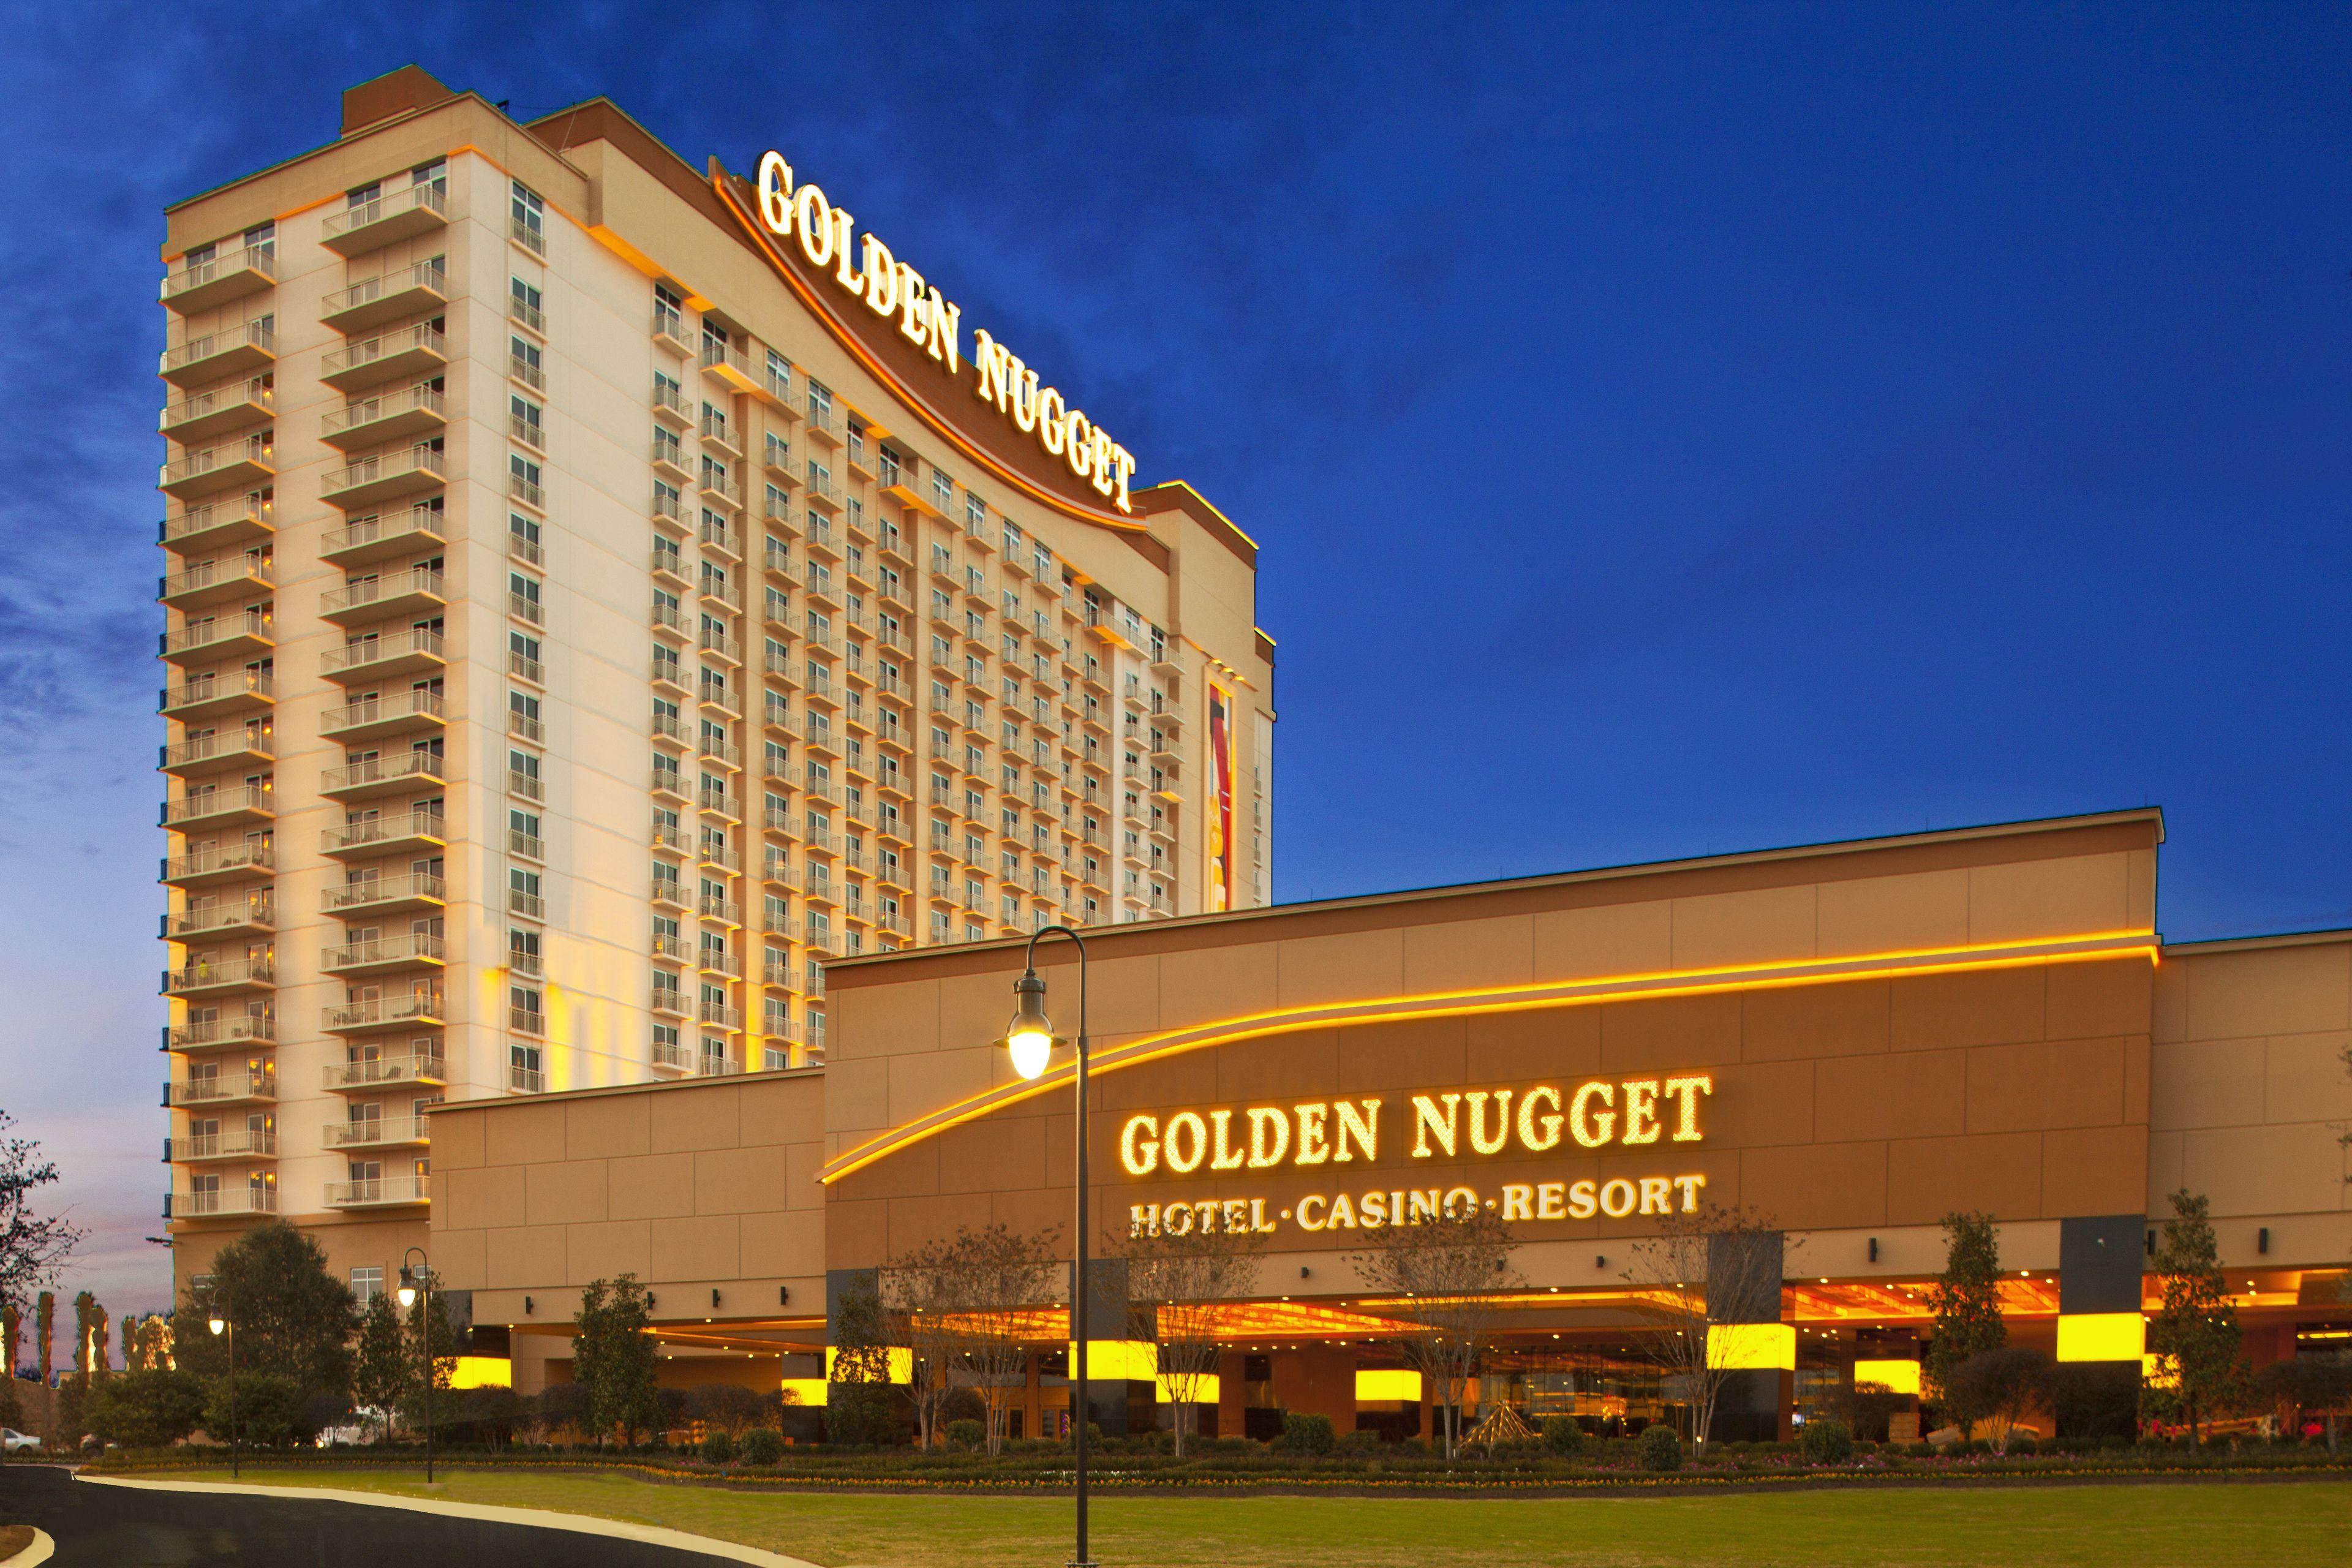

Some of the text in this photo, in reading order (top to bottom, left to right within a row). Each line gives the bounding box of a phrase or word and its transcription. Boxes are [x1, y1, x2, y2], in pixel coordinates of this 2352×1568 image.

[756, 149, 1135, 513] GOLDEN NUGGET
[1120, 1075, 1712, 1176] GOLDEN NUGGET
[1129, 1175, 1705, 1238] HOTEL CASINO RESORT
